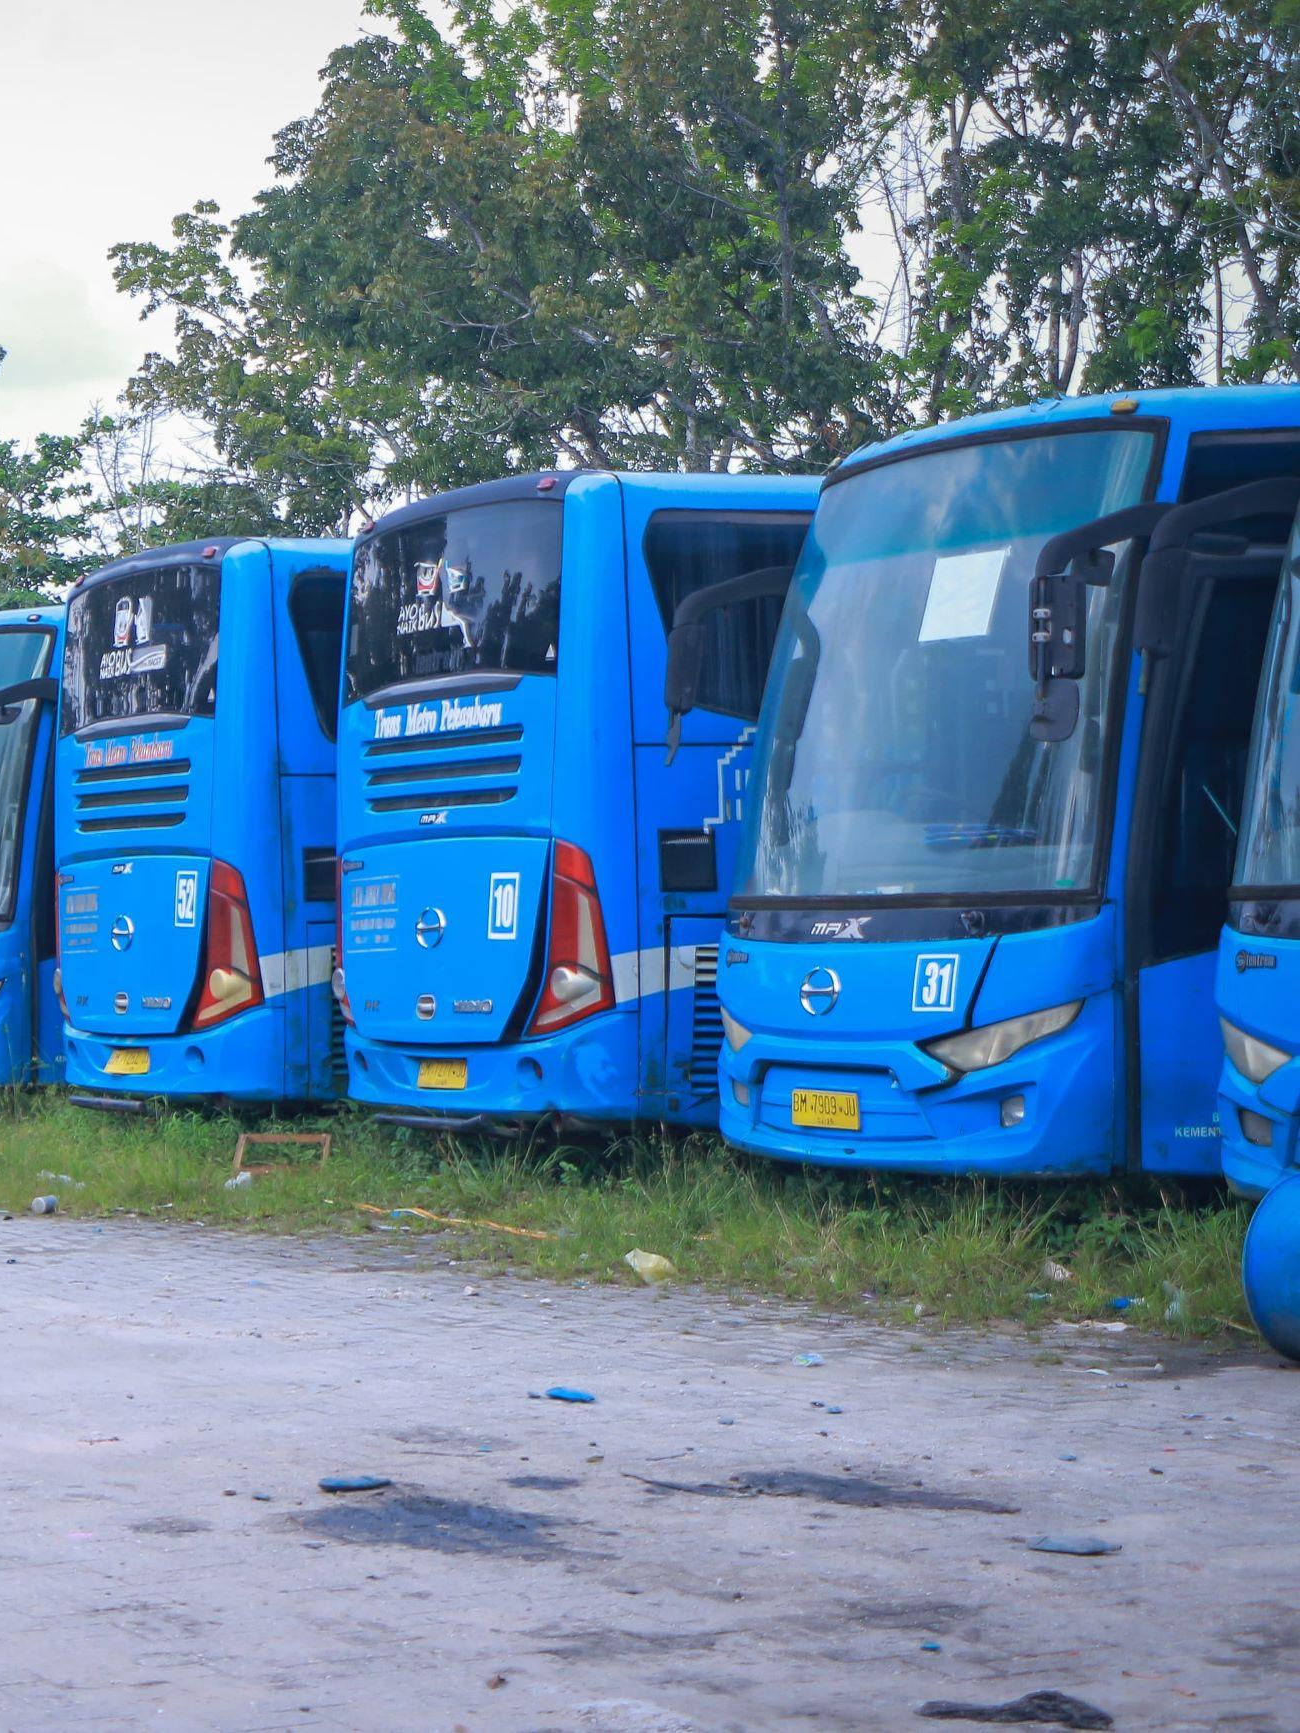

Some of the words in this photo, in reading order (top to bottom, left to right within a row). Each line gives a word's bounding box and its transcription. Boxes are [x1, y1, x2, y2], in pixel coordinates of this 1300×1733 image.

[398, 603, 418, 623] AYO
[417, 600, 441, 632] BUS
[114, 648, 133, 676] BUS
[374, 708, 402, 738] Trans
[405, 703, 437, 736] Metro
[440, 695, 502, 731] Pekanbaru
[177, 878, 195, 920] 52
[493, 883, 514, 929] 10
[922, 961, 953, 1006] 31
[793, 1092, 808, 1113] BM
[812, 1093, 838, 1116] 7909
[843, 1096, 857, 1117] JU
